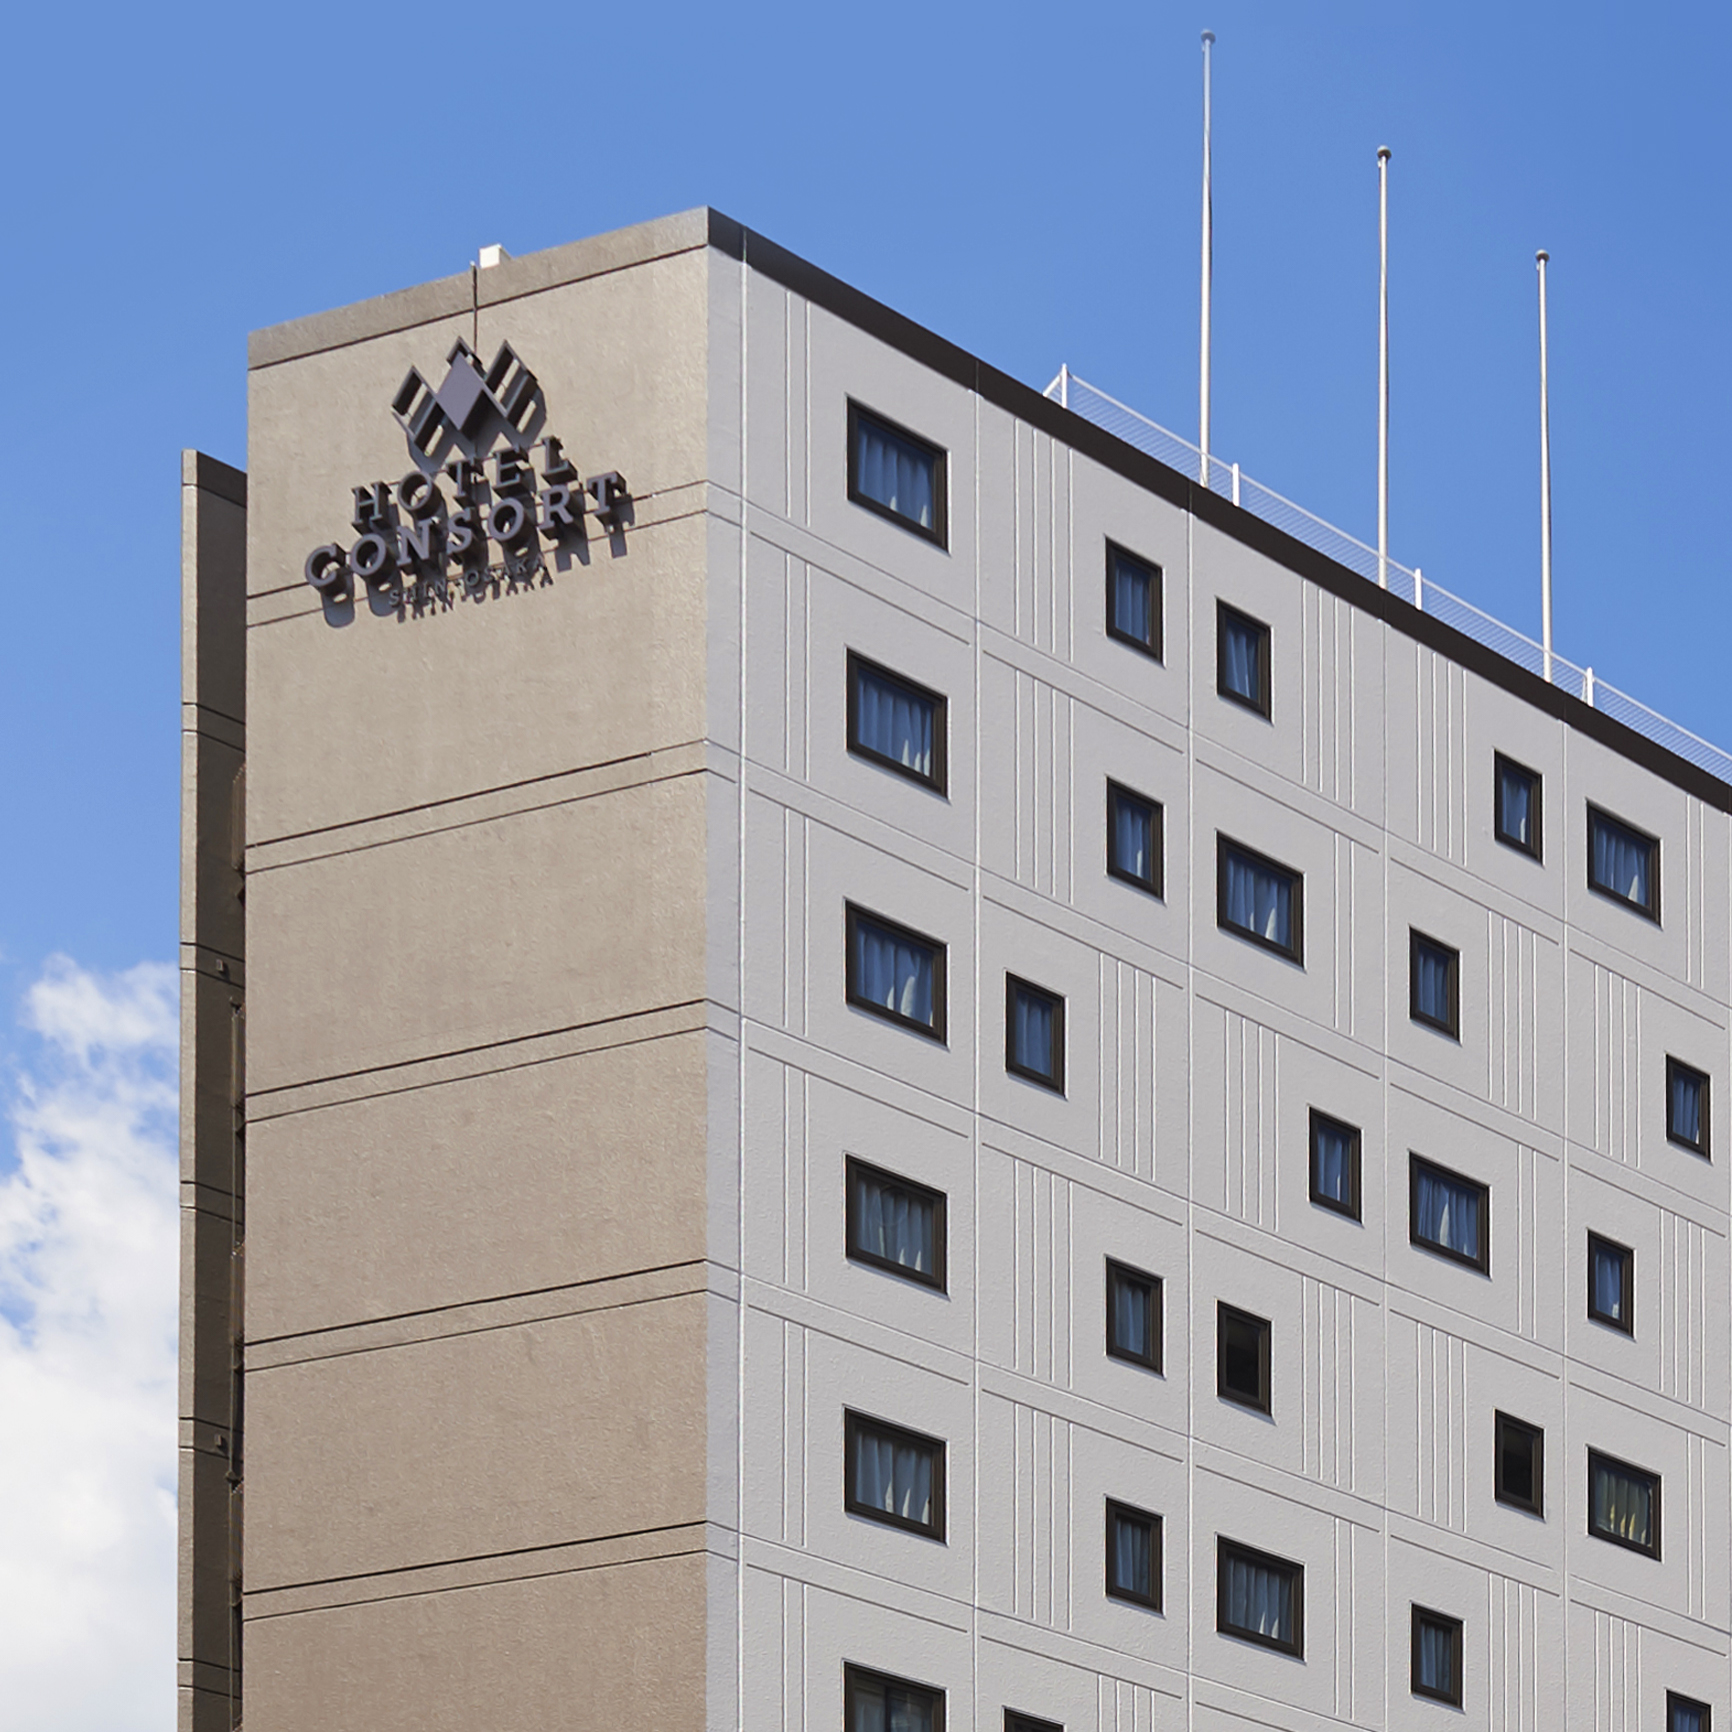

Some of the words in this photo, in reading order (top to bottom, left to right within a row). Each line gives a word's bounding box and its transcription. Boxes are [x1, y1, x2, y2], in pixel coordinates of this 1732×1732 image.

[305, 471, 626, 590] CONSORT
[351, 436, 577, 532] HOTEL
[389, 553, 545, 606] SHIN-OSAKA
